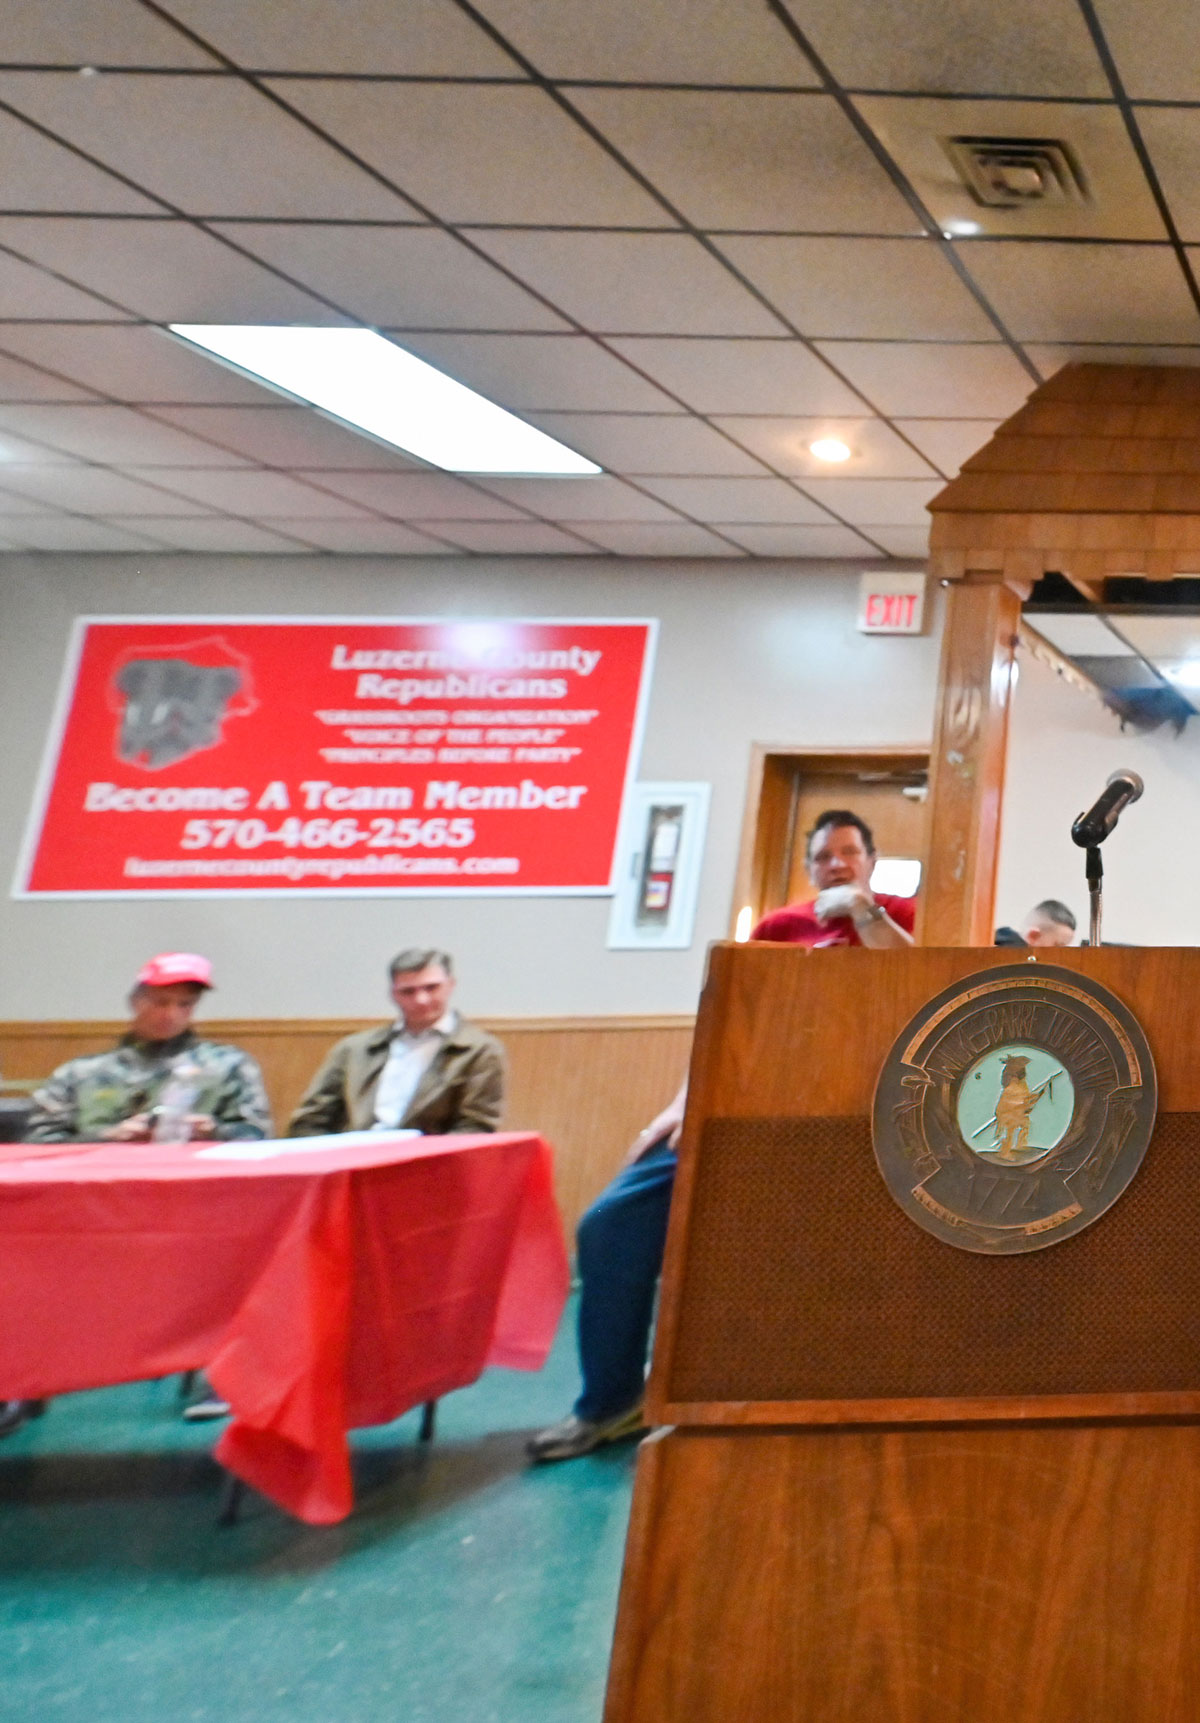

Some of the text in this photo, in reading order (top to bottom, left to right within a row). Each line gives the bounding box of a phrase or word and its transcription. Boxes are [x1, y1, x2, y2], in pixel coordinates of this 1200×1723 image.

[865, 593, 919, 628] EXIT
[354, 673, 569, 705] Republicans
[84, 779, 589, 813] Become A Team Member
[179, 816, 477, 850] 570-466-2565
